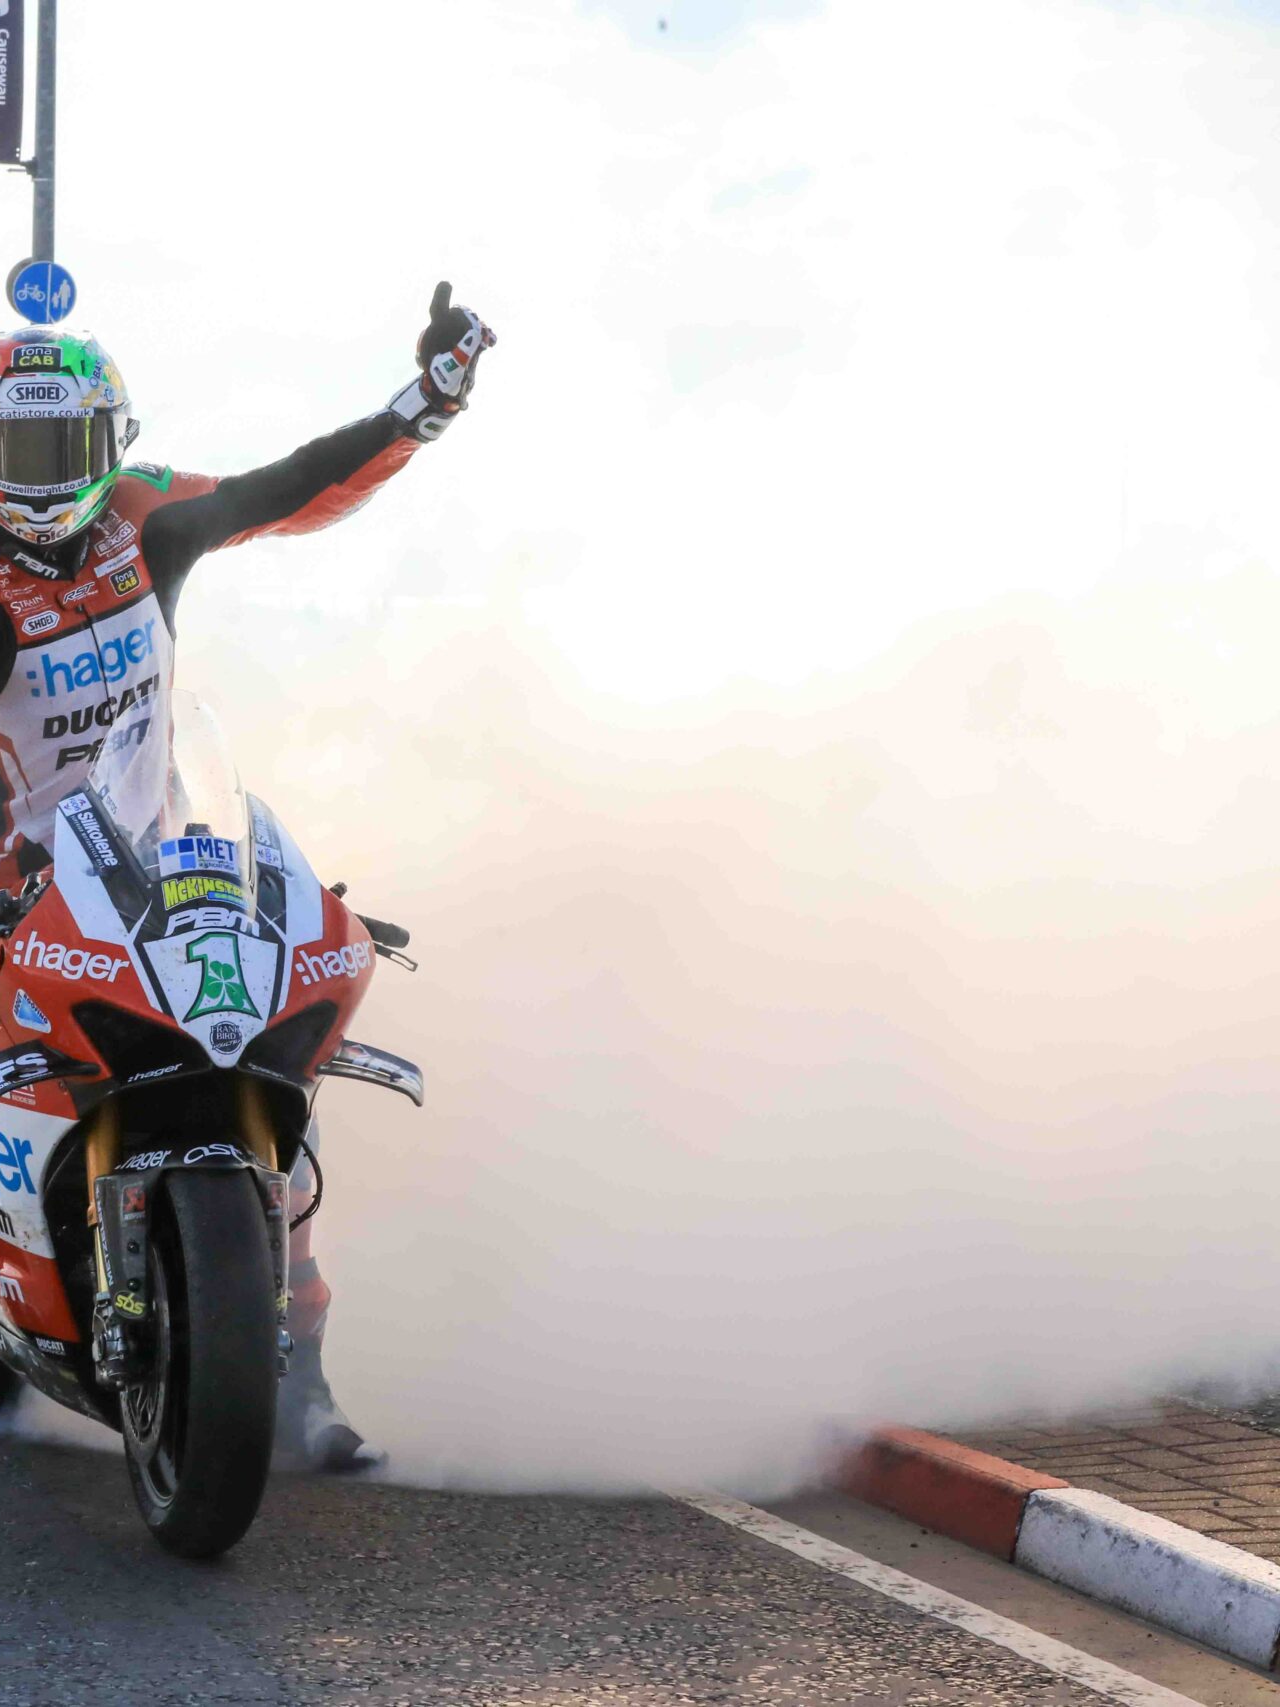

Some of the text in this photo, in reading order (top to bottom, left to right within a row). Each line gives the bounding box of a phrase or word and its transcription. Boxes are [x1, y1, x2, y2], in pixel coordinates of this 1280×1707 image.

[19, 355, 54, 366] CAB
[16, 386, 59, 400] SHOEI
[114, 570, 134, 583] fona
[118, 576, 137, 591] CAB
[63, 582, 95, 604] RST
[10, 595, 44, 614] STRAIN
[28, 615, 53, 630] SHOEI
[42, 672, 159, 739] DUCATI
[77, 811, 119, 867] Silkolene
[196, 838, 234, 862] MET
[182, 931, 263, 1023] 1
[210, 1025, 239, 1033] FRANK
[216, 1032, 237, 1040] BIRD
[35, 1337, 65, 1352] DUCATI
